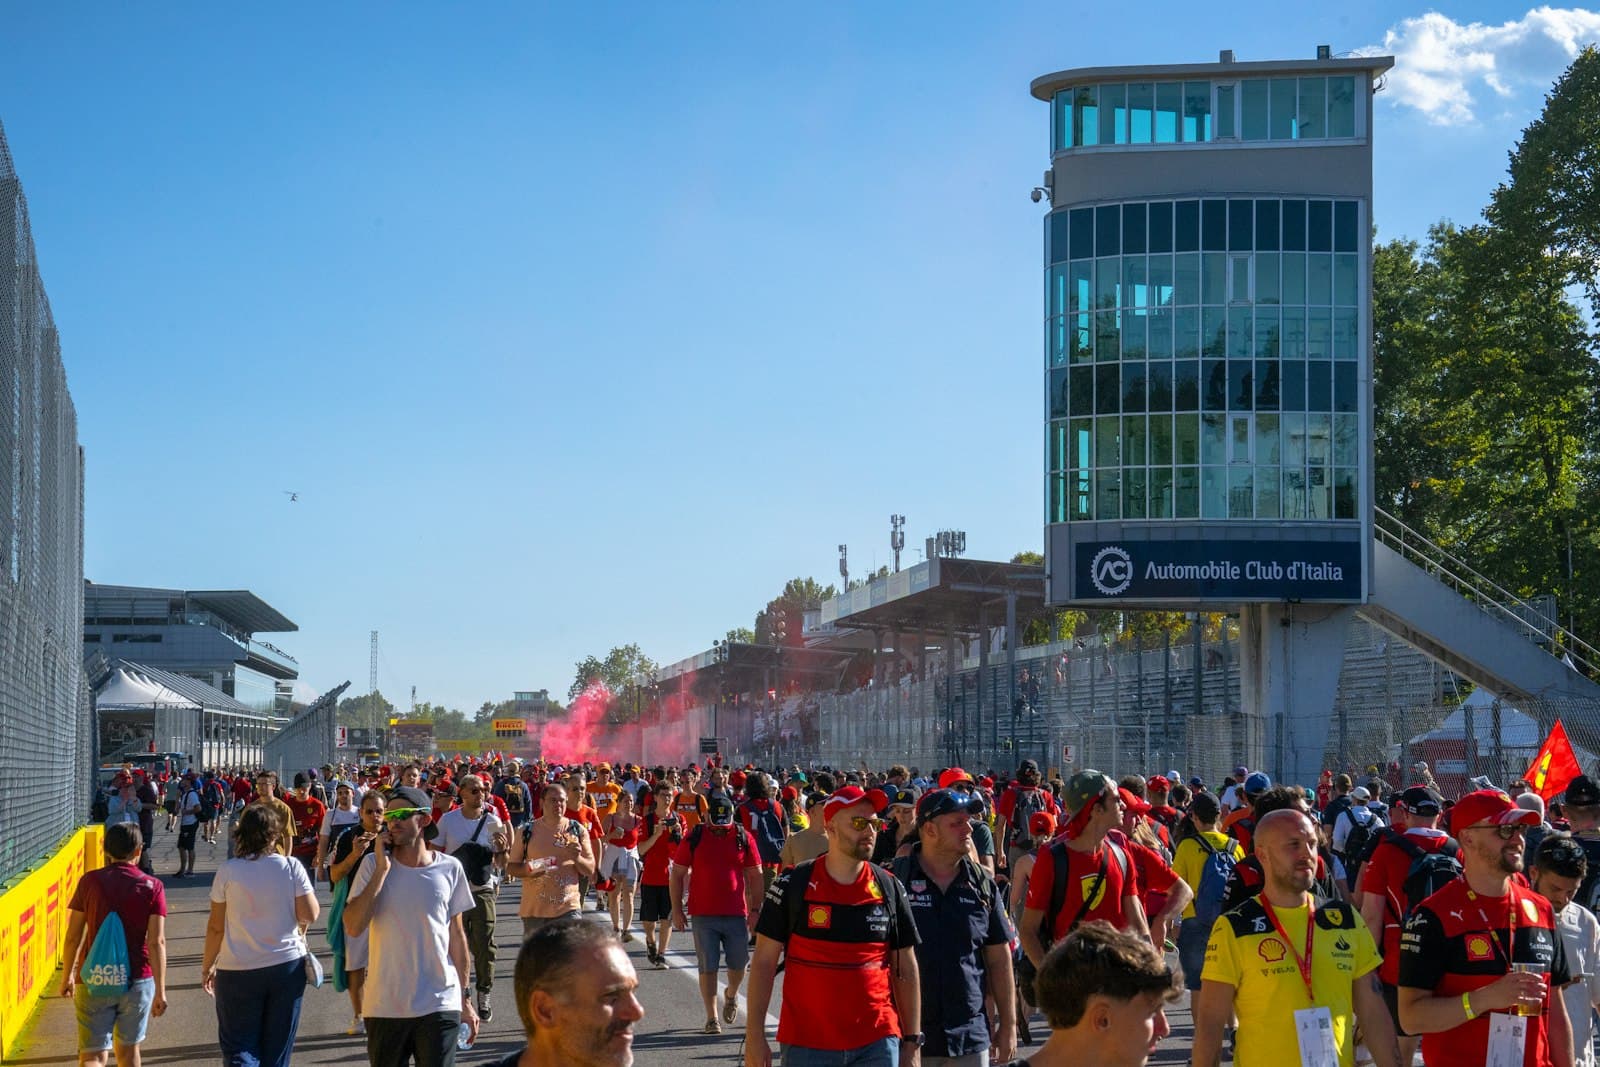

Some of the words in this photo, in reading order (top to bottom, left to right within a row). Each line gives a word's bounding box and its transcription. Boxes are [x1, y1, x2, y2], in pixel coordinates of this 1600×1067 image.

[1145, 560, 1240, 580] Automobile
[1245, 560, 1283, 580] Club
[1286, 560, 1343, 581] d'Italia
